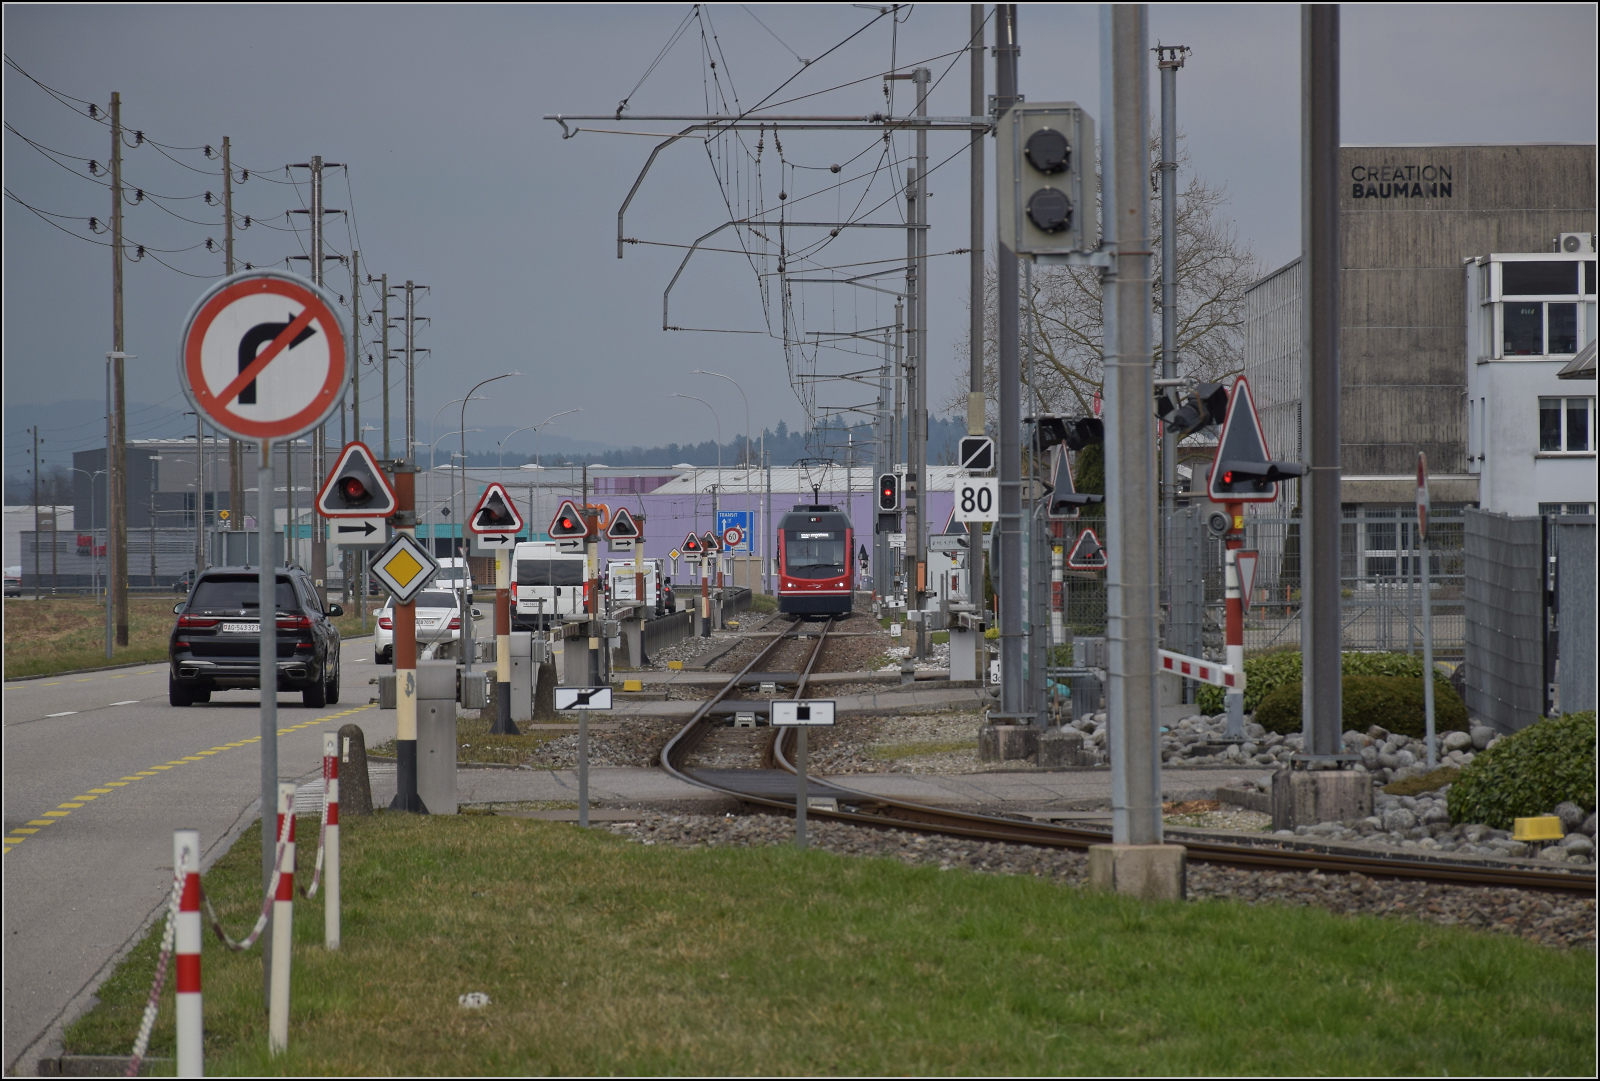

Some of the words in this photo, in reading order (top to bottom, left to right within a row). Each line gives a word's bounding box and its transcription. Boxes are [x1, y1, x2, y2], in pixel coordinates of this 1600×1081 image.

[1351, 165, 1452, 181] CREATION
[1352, 182, 1452, 199] BAUMANN
[961, 486, 992, 513] 80
[728, 532, 737, 541] 60
[996, 663, 1000, 672] 1
